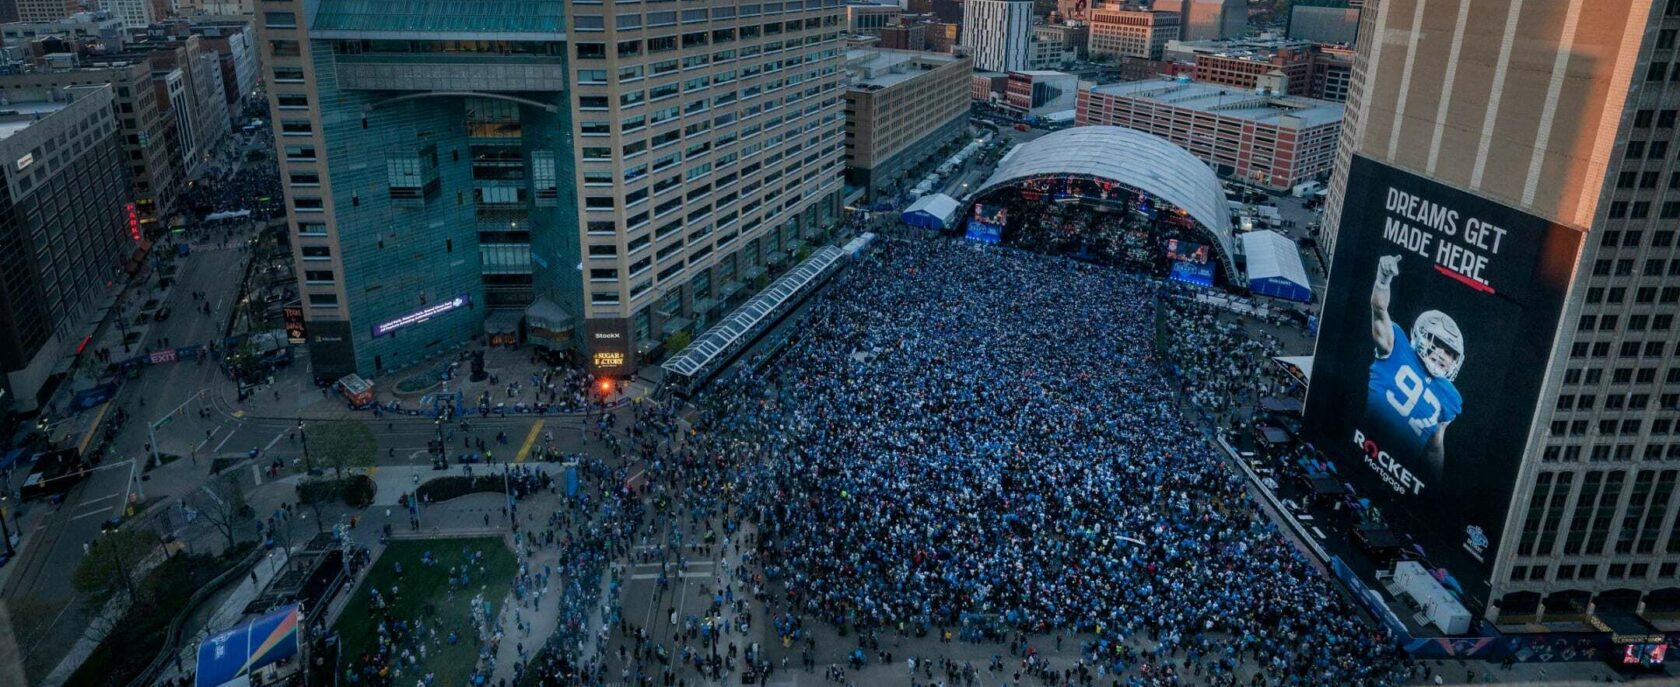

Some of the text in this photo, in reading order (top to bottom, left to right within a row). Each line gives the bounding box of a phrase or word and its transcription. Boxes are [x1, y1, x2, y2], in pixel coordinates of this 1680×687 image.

[1383, 216, 1489, 286] MADE HERE.
[1385, 187, 1507, 254] DREAMS GET
[151, 352, 176, 363] EXIT
[1385, 364, 1441, 437] 97
[1353, 428, 1425, 495] ROCKET
[1364, 454, 1406, 495] Mortgage
